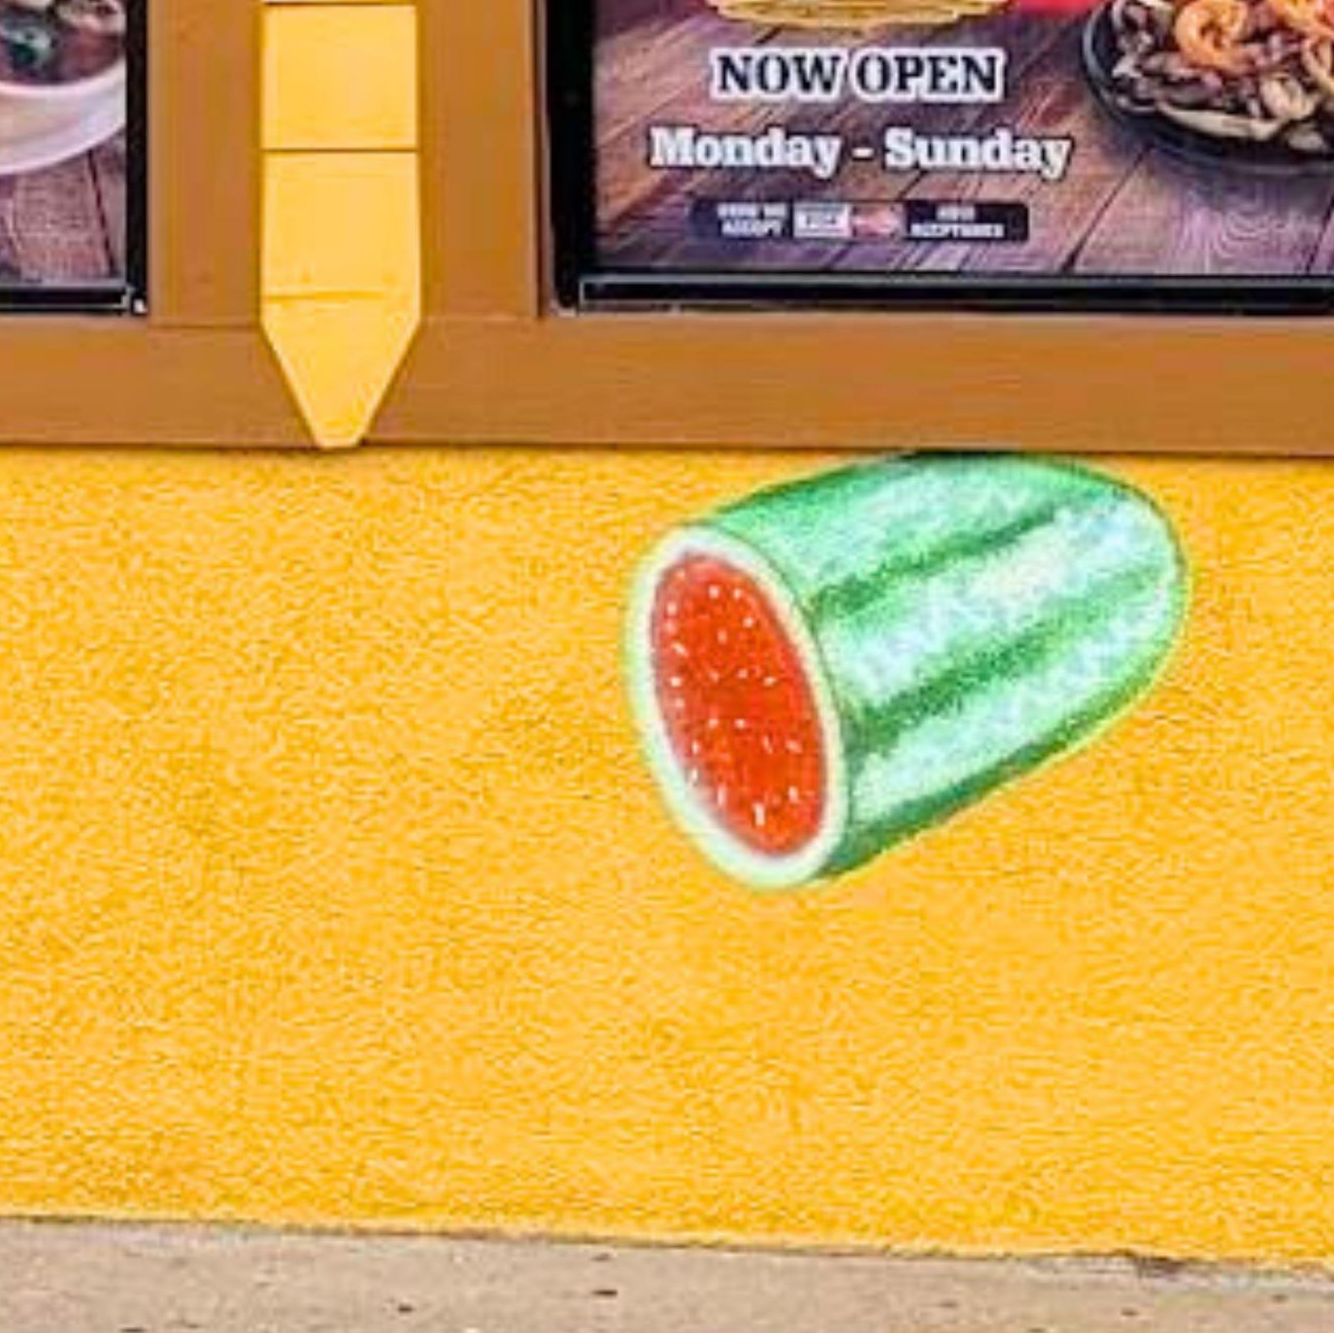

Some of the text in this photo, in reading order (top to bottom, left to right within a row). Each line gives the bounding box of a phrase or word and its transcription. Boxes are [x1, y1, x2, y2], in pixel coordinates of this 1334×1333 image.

[714, 51, 1002, 99] NOW OPEN
[650, 127, 842, 179] Monday
[883, 129, 1072, 180] Sunday
